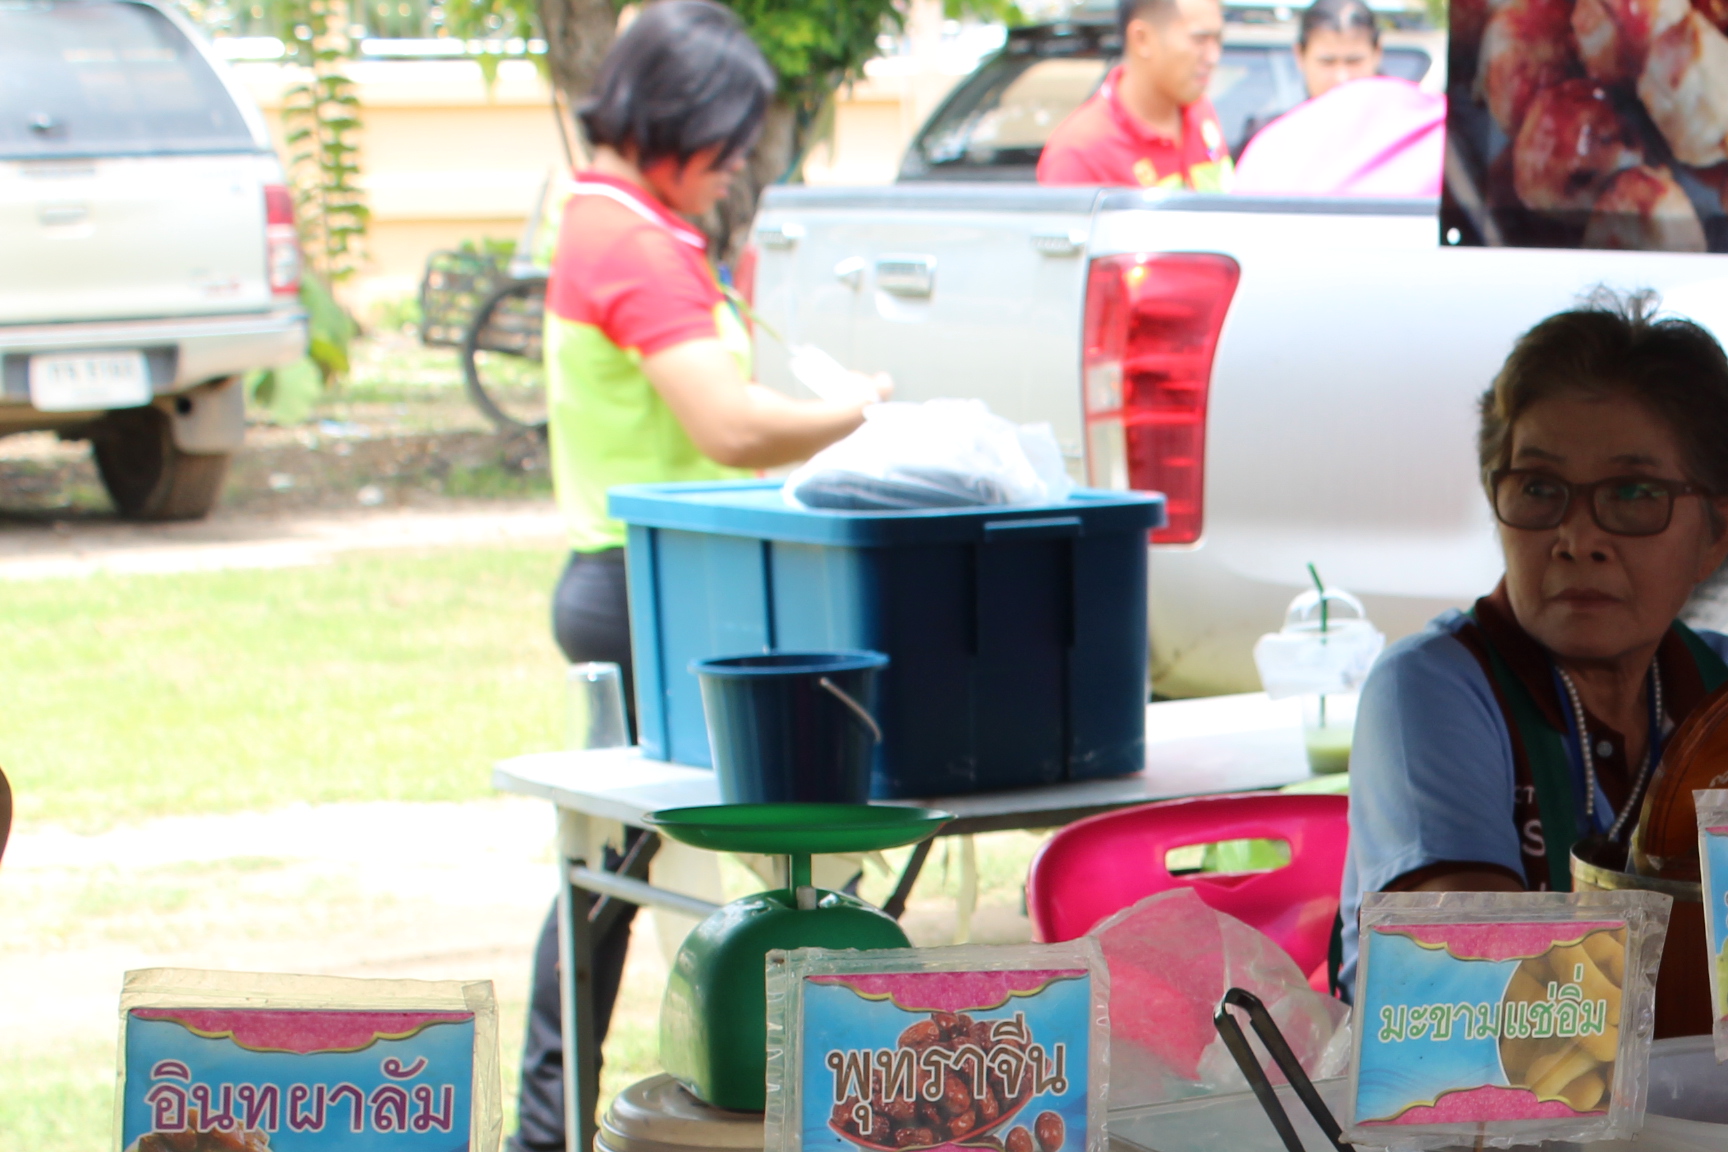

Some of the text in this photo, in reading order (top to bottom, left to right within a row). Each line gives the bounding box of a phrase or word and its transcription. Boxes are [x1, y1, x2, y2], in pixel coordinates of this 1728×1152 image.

[1379, 963, 1606, 1043] มะขามแช่อิ่ม
[145, 1057, 455, 1133] อินทผาลัม
[826, 1011, 1067, 1134] พุทราจีน
